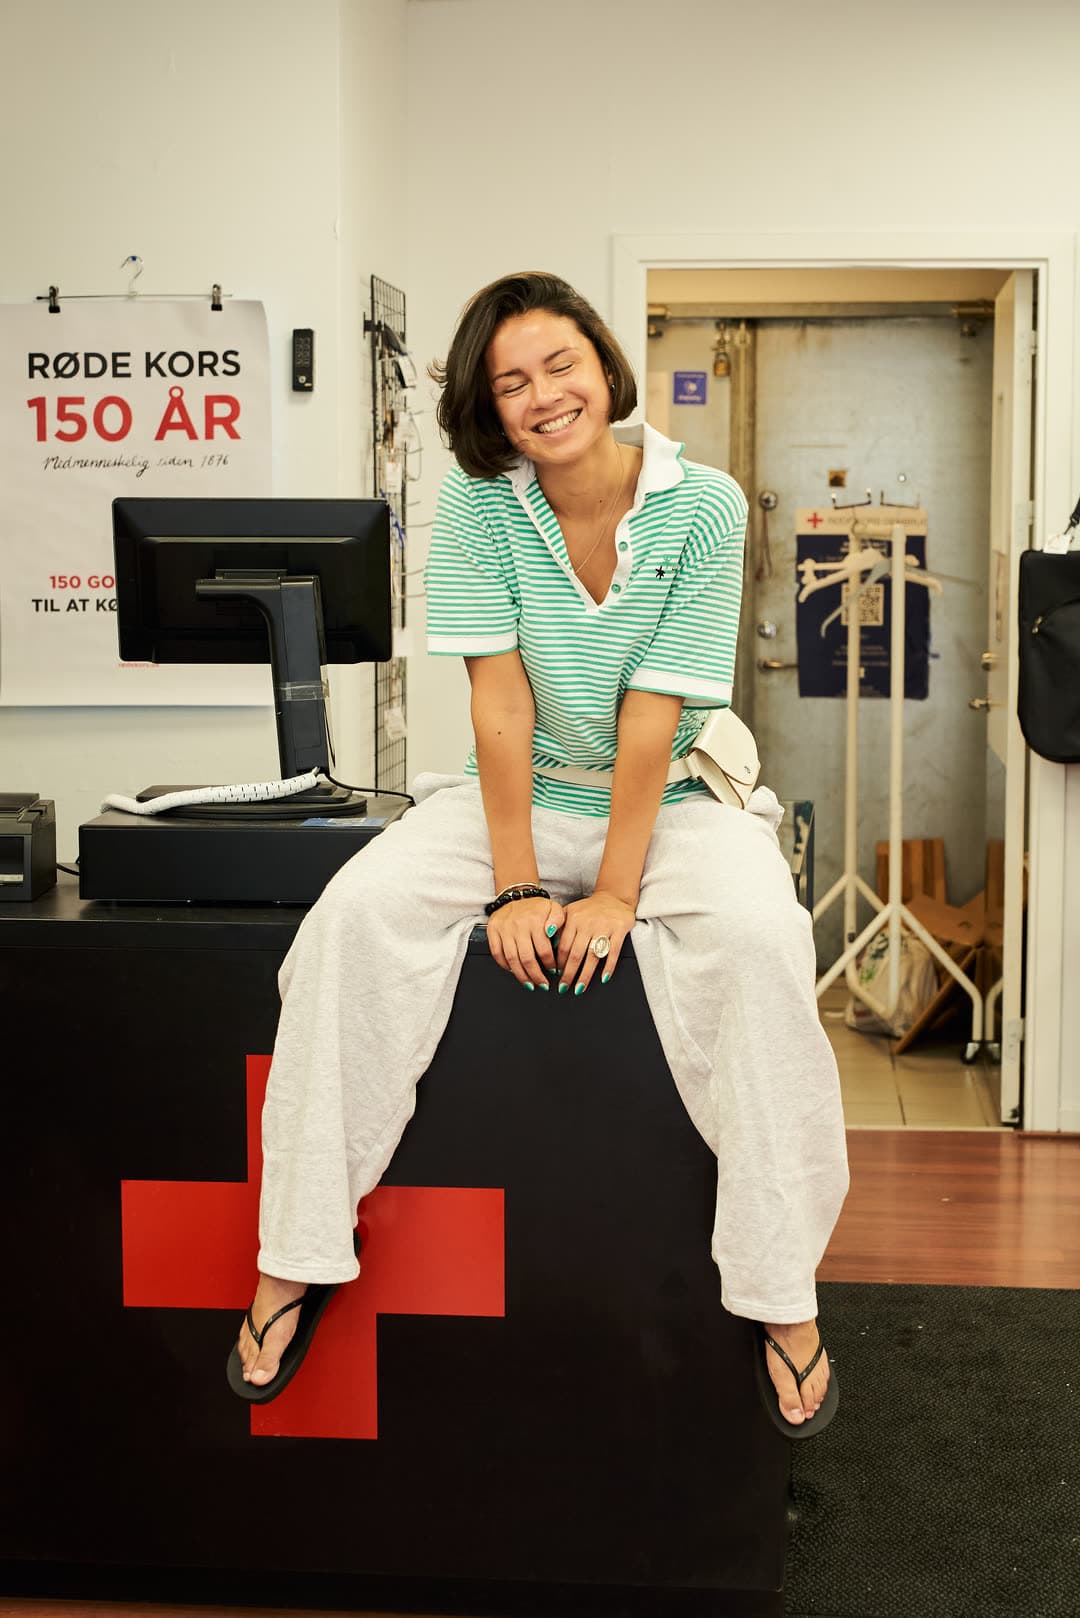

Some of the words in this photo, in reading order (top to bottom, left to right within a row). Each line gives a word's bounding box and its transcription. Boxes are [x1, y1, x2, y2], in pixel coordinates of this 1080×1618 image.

[28, 352, 132, 379] RØDE
[145, 350, 241, 378] KORS
[27, 395, 132, 442] 150
[154, 386, 241, 440] ÅR
[49, 575, 81, 589] 150
[87, 575, 115, 589] GO
[32, 598, 60, 612] TIL
[66, 598, 90, 612] AT
